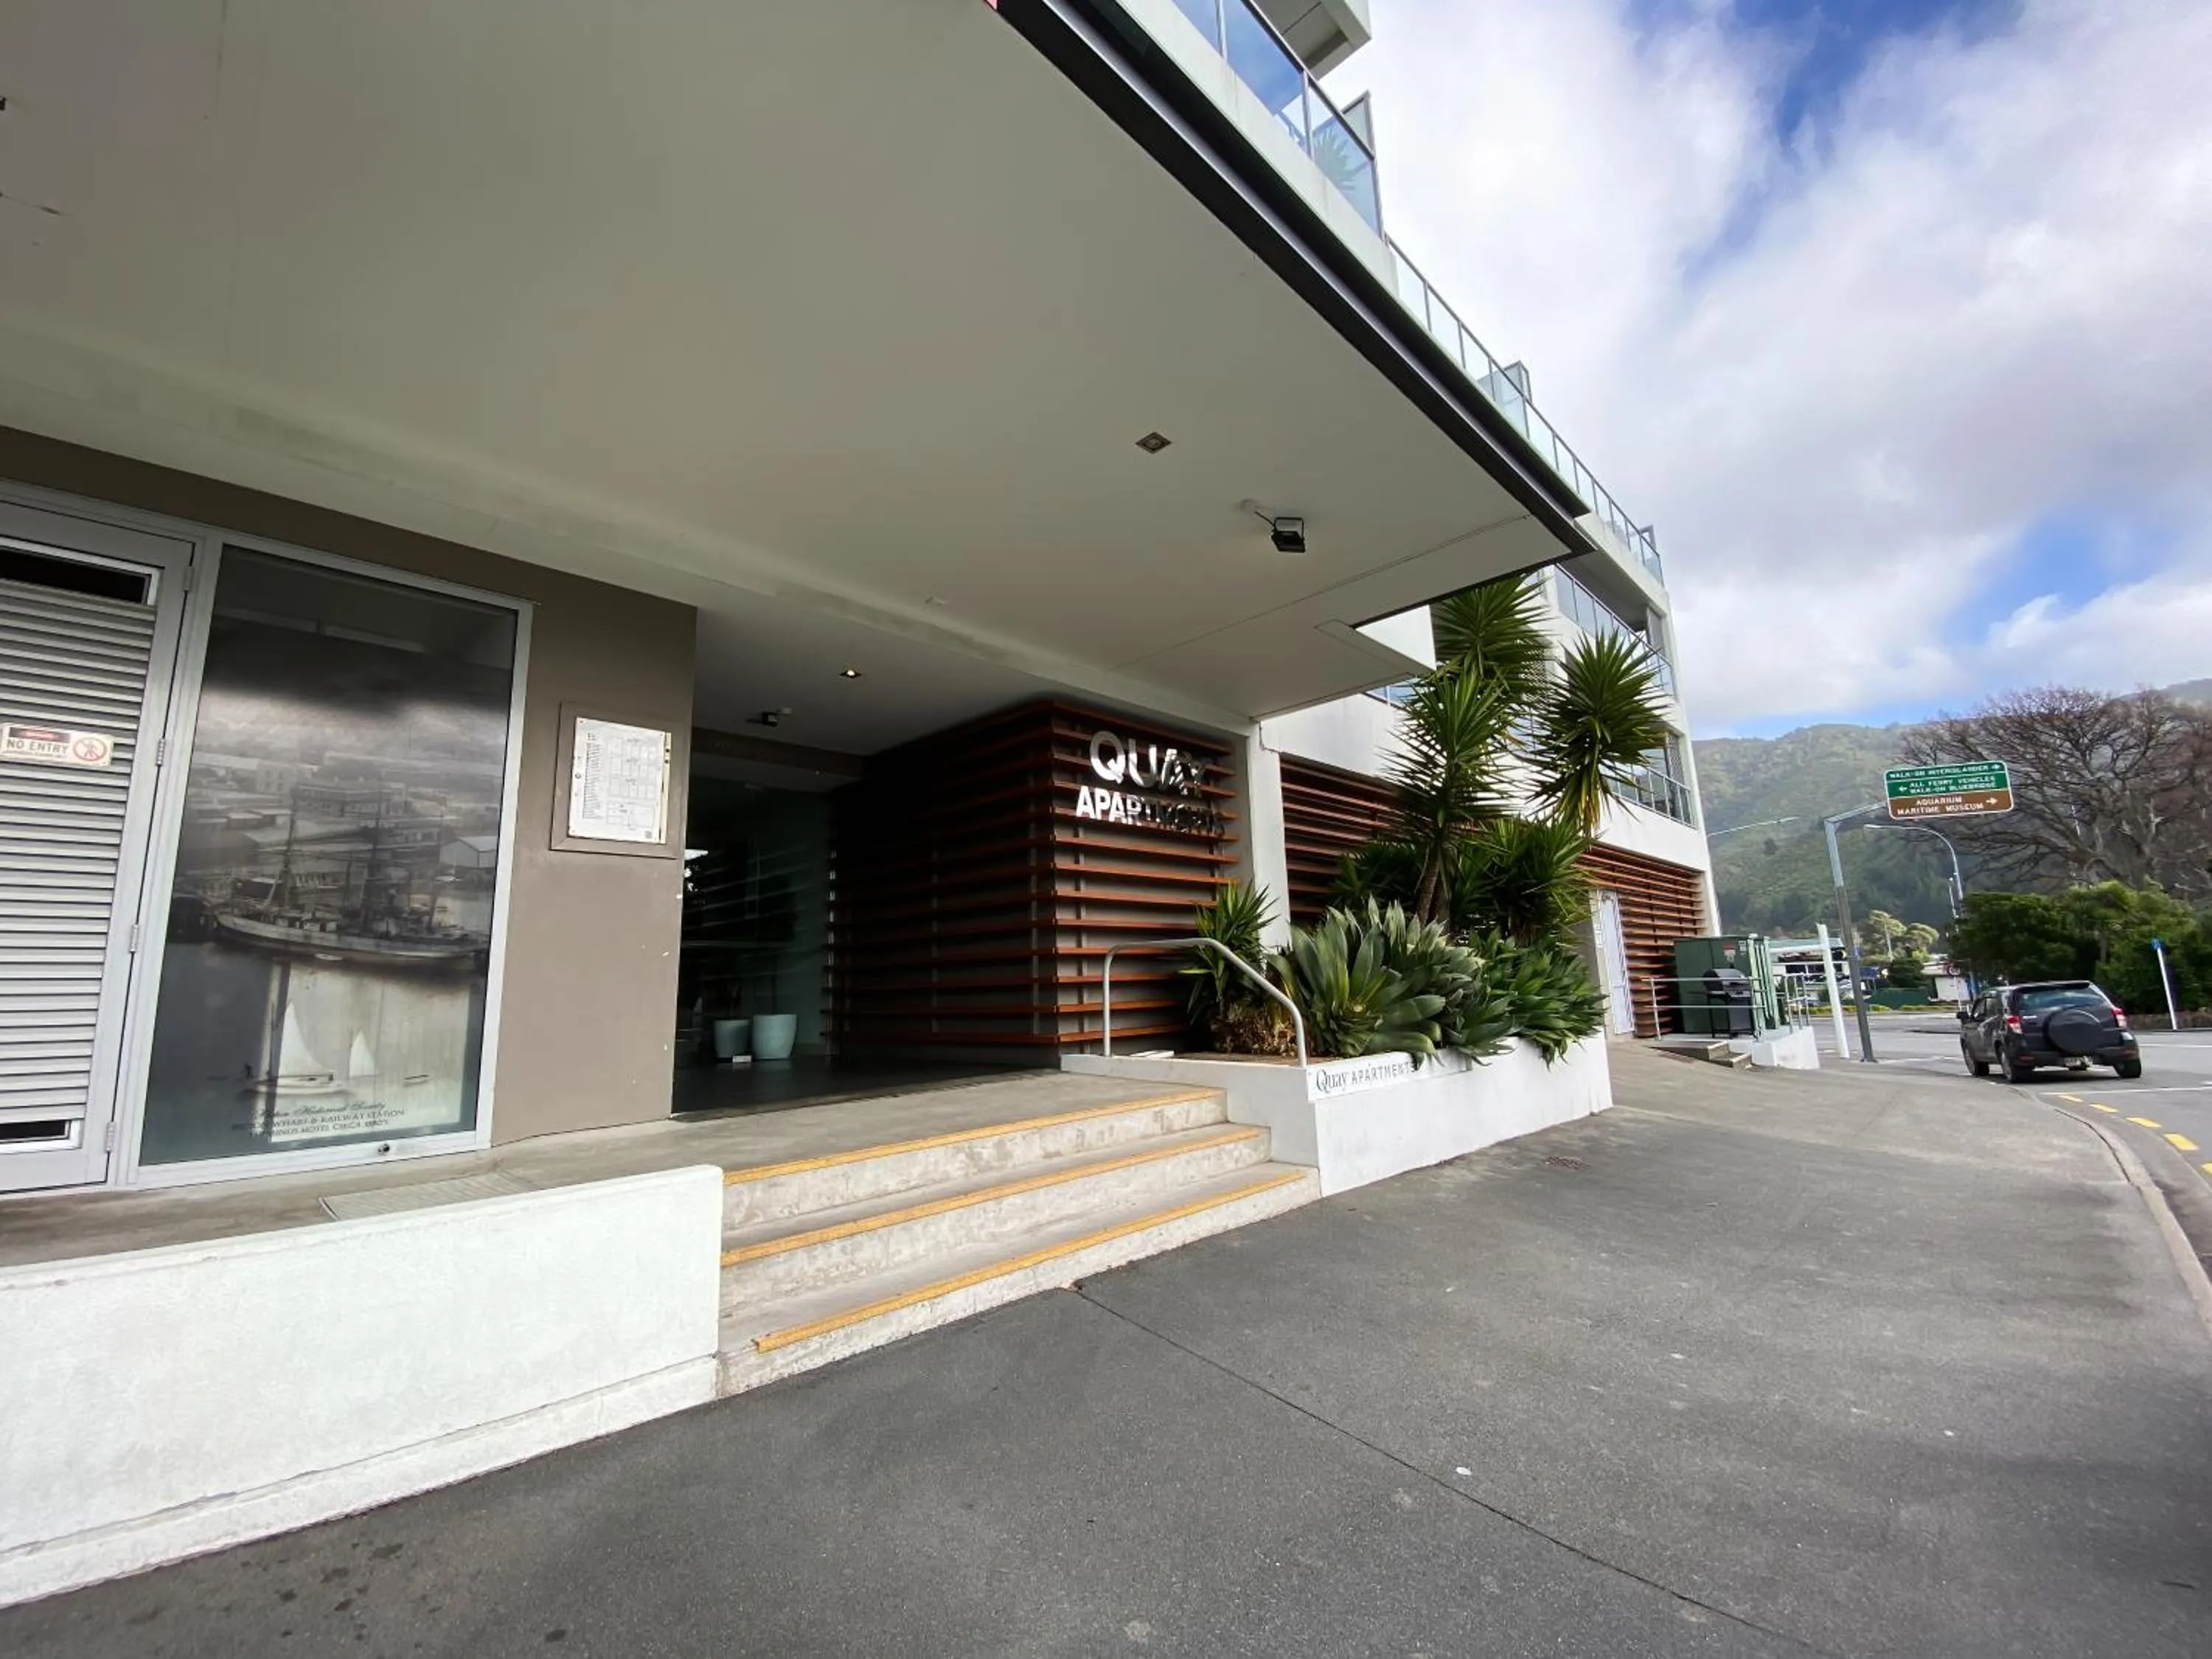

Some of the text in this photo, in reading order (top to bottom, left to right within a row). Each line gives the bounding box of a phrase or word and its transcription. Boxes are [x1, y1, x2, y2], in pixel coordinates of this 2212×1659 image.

[7, 739, 24, 749] NO
[29, 742, 69, 754] ENTRY
[1958, 776, 1995, 785] VEHICLES
[1916, 796, 1962, 805] AQUARIUM
[1897, 803, 1984, 815] MARITIME MUSEUM
[1315, 1060, 1416, 1093] Quay APARTMENTS
[321, 1113, 364, 1123] RAILWAY
[367, 1108, 405, 1118] STATION
